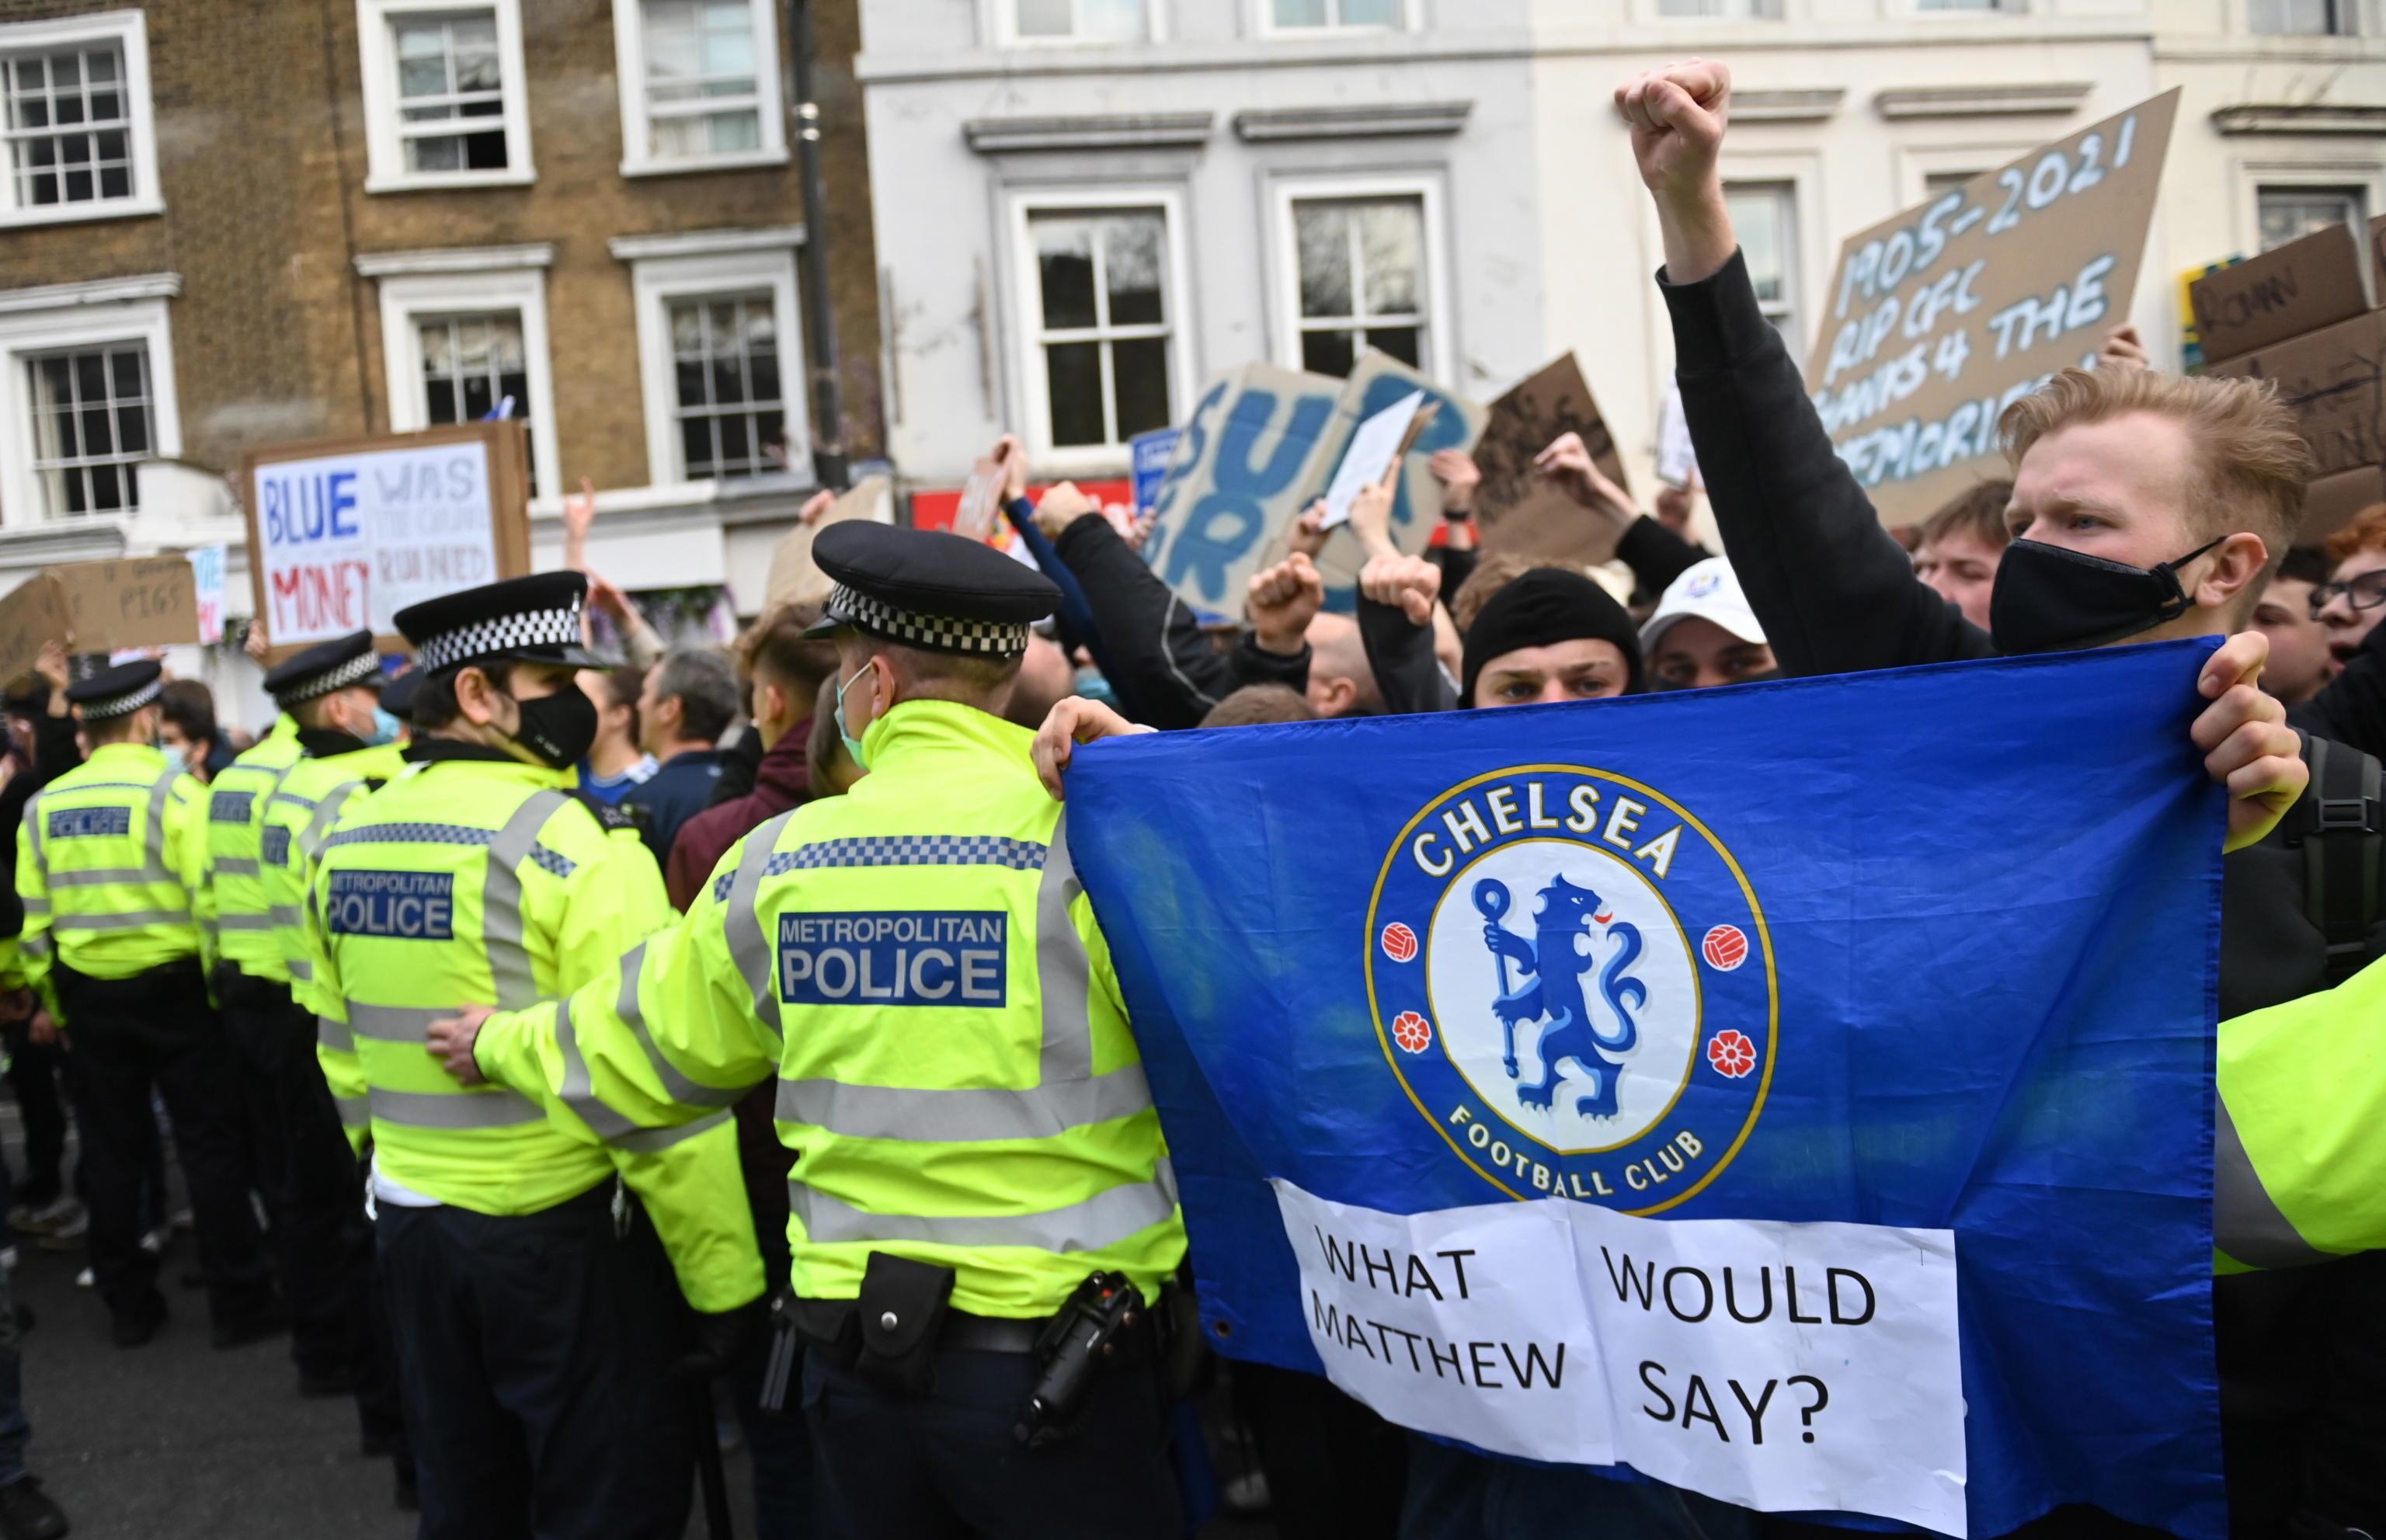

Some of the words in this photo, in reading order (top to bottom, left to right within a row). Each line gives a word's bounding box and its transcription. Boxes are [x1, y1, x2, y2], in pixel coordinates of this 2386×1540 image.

[1822, 297, 1901, 385] RIP
[1901, 259, 1986, 339] CFC
[1933, 329, 1971, 383] 4
[1988, 254, 2116, 359] THE
[264, 471, 359, 544] BLUE
[374, 458, 475, 504] WAS
[272, 560, 370, 634] MONEY
[1413, 782, 1684, 880] CHELSEA
[329, 895, 450, 937] POLICE
[781, 917, 1002, 943] METROPOLITAN
[781, 947, 1001, 1000] POLICE
[1449, 1104, 1614, 1198] FOOTBALL
[1625, 1130, 1704, 1191] CLUB
[1314, 1225, 1476, 1301] WHAT
[1600, 1246, 1876, 1326] WOULD
[1312, 1289, 1566, 1390] MATTHEW
[1637, 1360, 1829, 1445] SAY?
